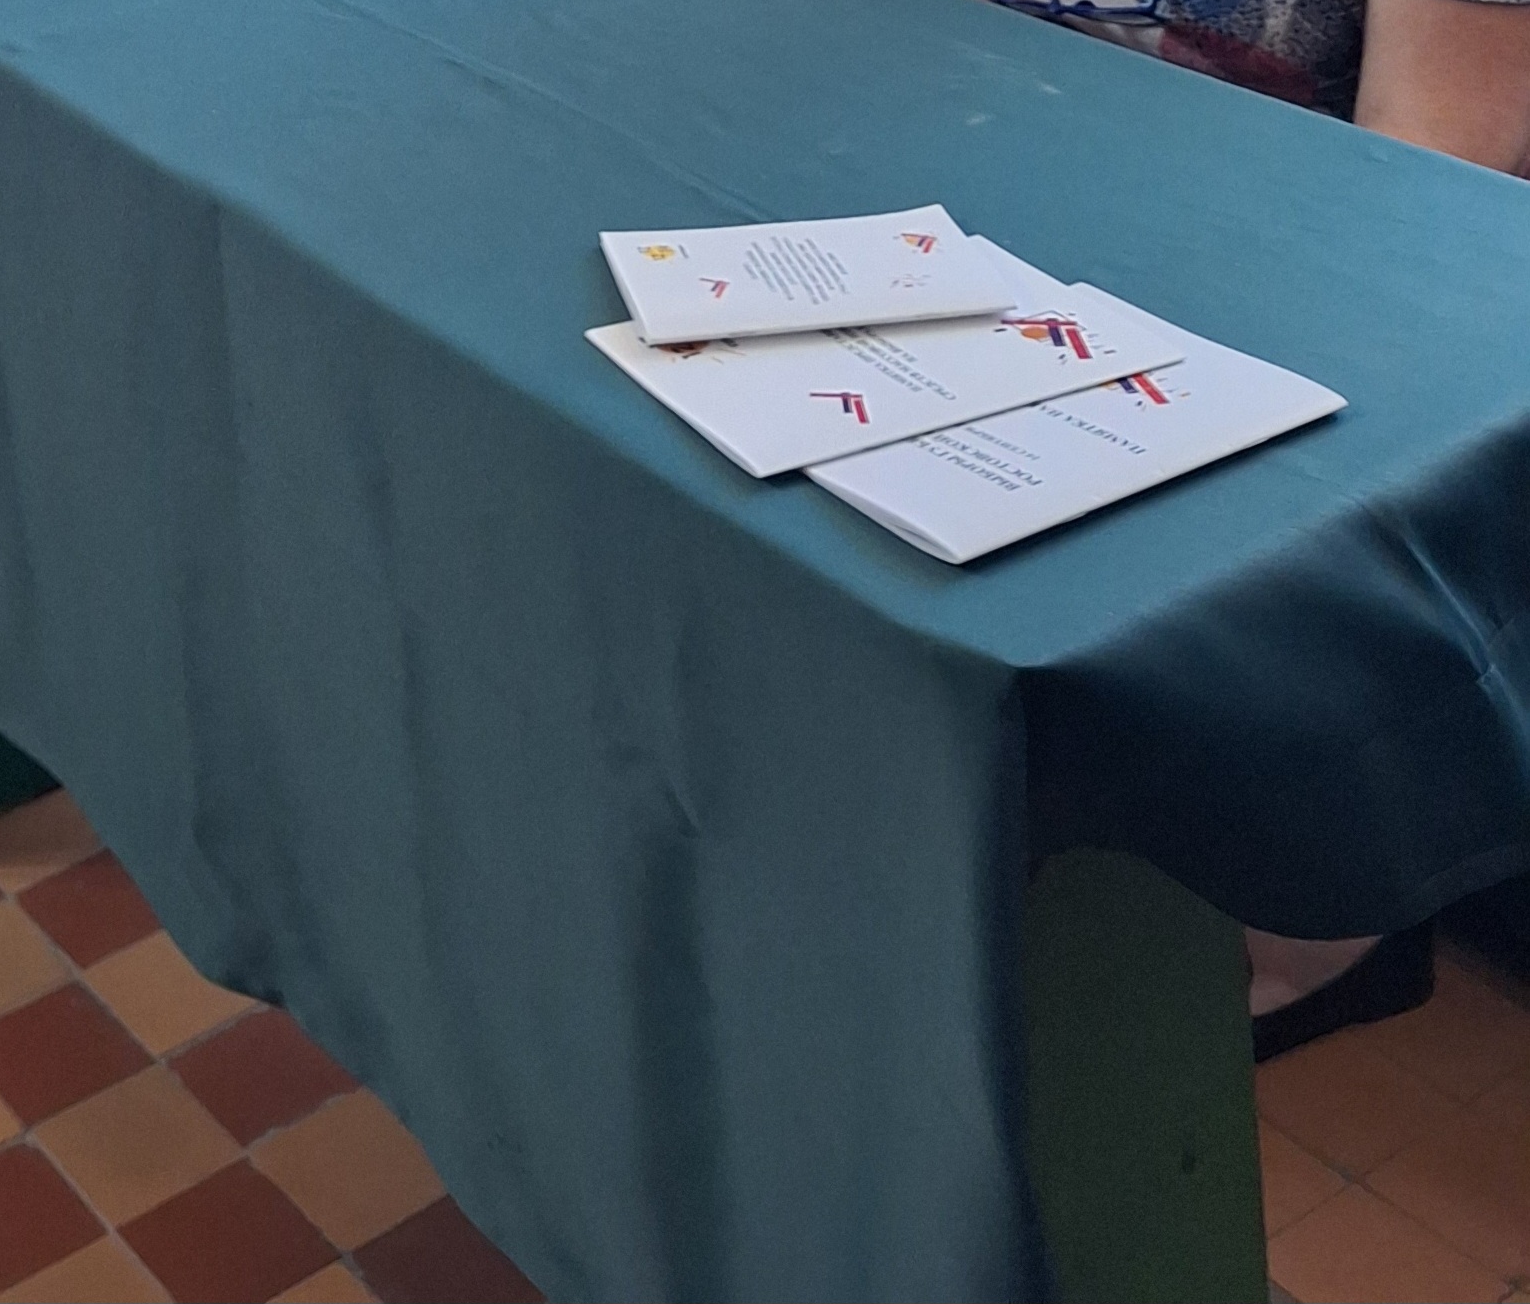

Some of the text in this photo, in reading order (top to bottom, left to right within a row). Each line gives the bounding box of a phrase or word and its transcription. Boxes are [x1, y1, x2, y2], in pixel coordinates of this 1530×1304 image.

[1065, 414, 1147, 455] ПАМЯТКА
[932, 433, 1044, 487] РОСТОВСКОЙ
[945, 456, 1022, 492] ВЫБОРЫ
